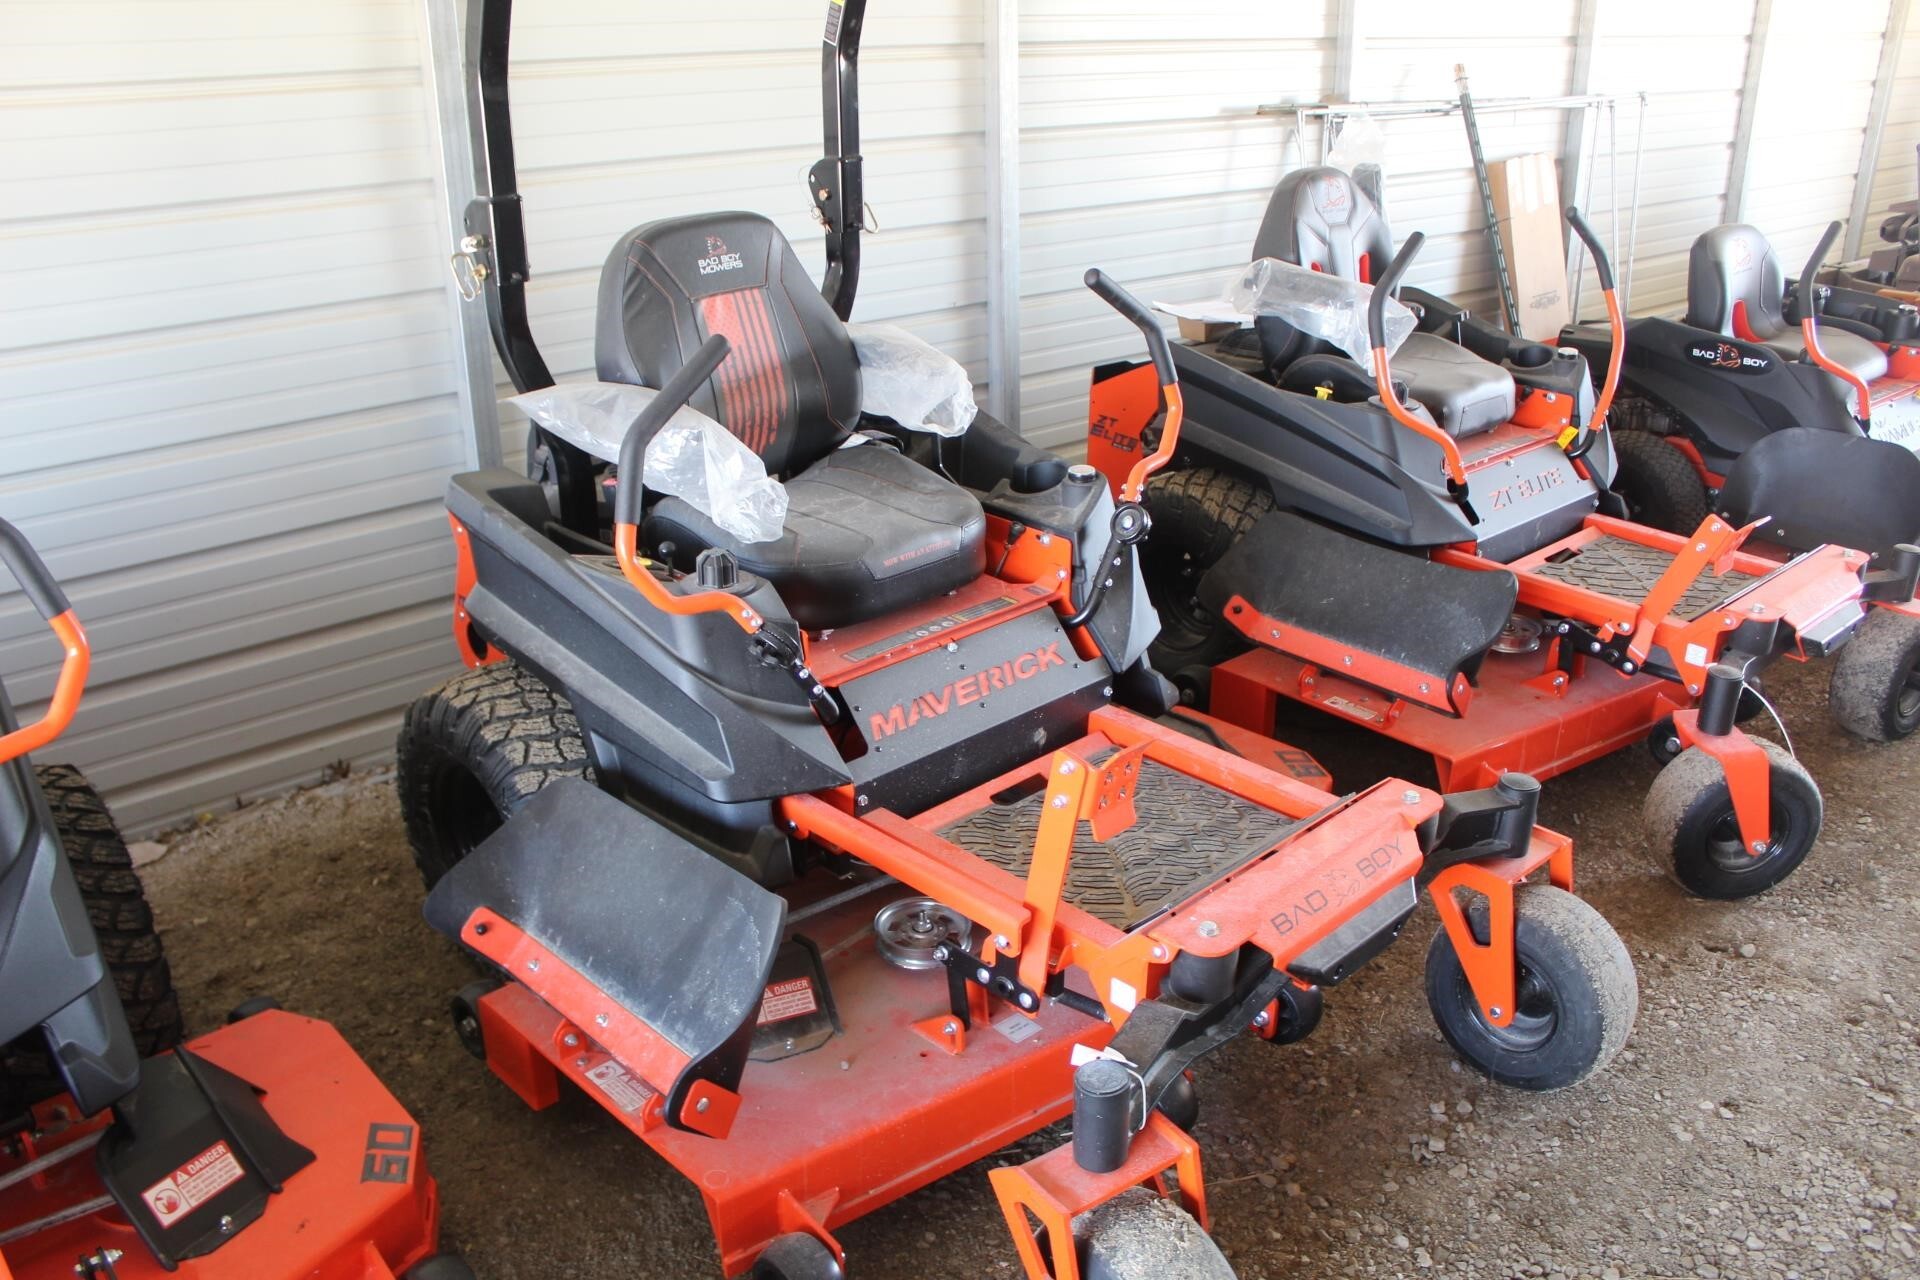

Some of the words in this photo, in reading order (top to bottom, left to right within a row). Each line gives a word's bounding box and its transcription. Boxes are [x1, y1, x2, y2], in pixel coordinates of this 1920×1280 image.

[697, 256, 719, 268] BAD
[720, 252, 740, 263] BOY
[700, 259, 744, 276] MOWERS
[1692, 348, 1715, 359] BAD
[1742, 357, 1768, 368] BOY
[1488, 485, 1513, 511] ZT
[1516, 468, 1565, 499] ELITE
[868, 640, 1066, 743] MAVERICK
[1270, 889, 1329, 936] BAD
[1355, 836, 1403, 879] BOY
[774, 979, 809, 996] DANGER
[186, 1144, 227, 1174] DANGER
